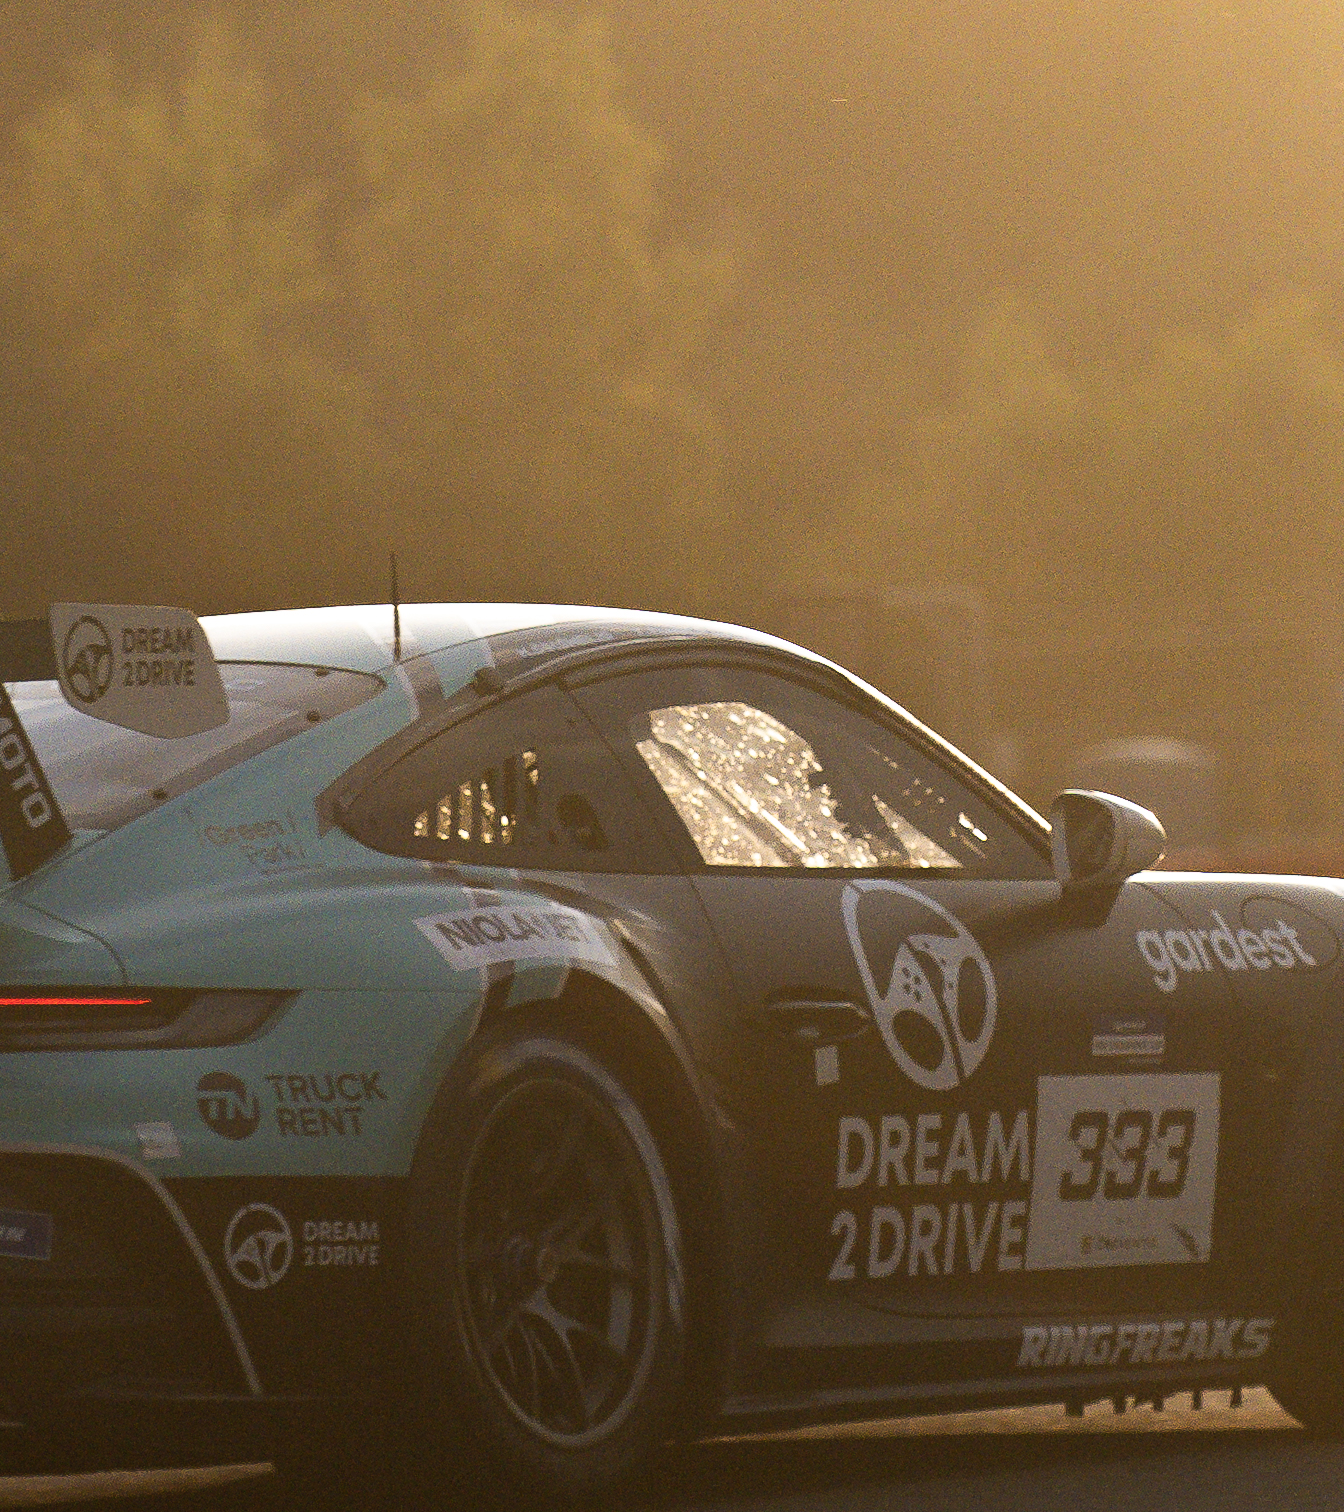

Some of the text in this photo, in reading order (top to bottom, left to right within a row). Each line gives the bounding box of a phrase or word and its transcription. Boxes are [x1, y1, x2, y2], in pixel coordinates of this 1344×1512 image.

[122, 627, 194, 654] DREAM
[122, 659, 194, 687] 2DRIVE
[1135, 908, 1317, 995] gardest
[265, 1071, 388, 1103] TRUCK
[274, 1105, 364, 1138] RENT
[836, 1110, 1031, 1189] DREAM
[1059, 1109, 1196, 1202] 333
[304, 1221, 379, 1243] DREAM
[304, 1245, 379, 1267] 2DRIVE
[1016, 1318, 1277, 1367] RINGFREAKS
